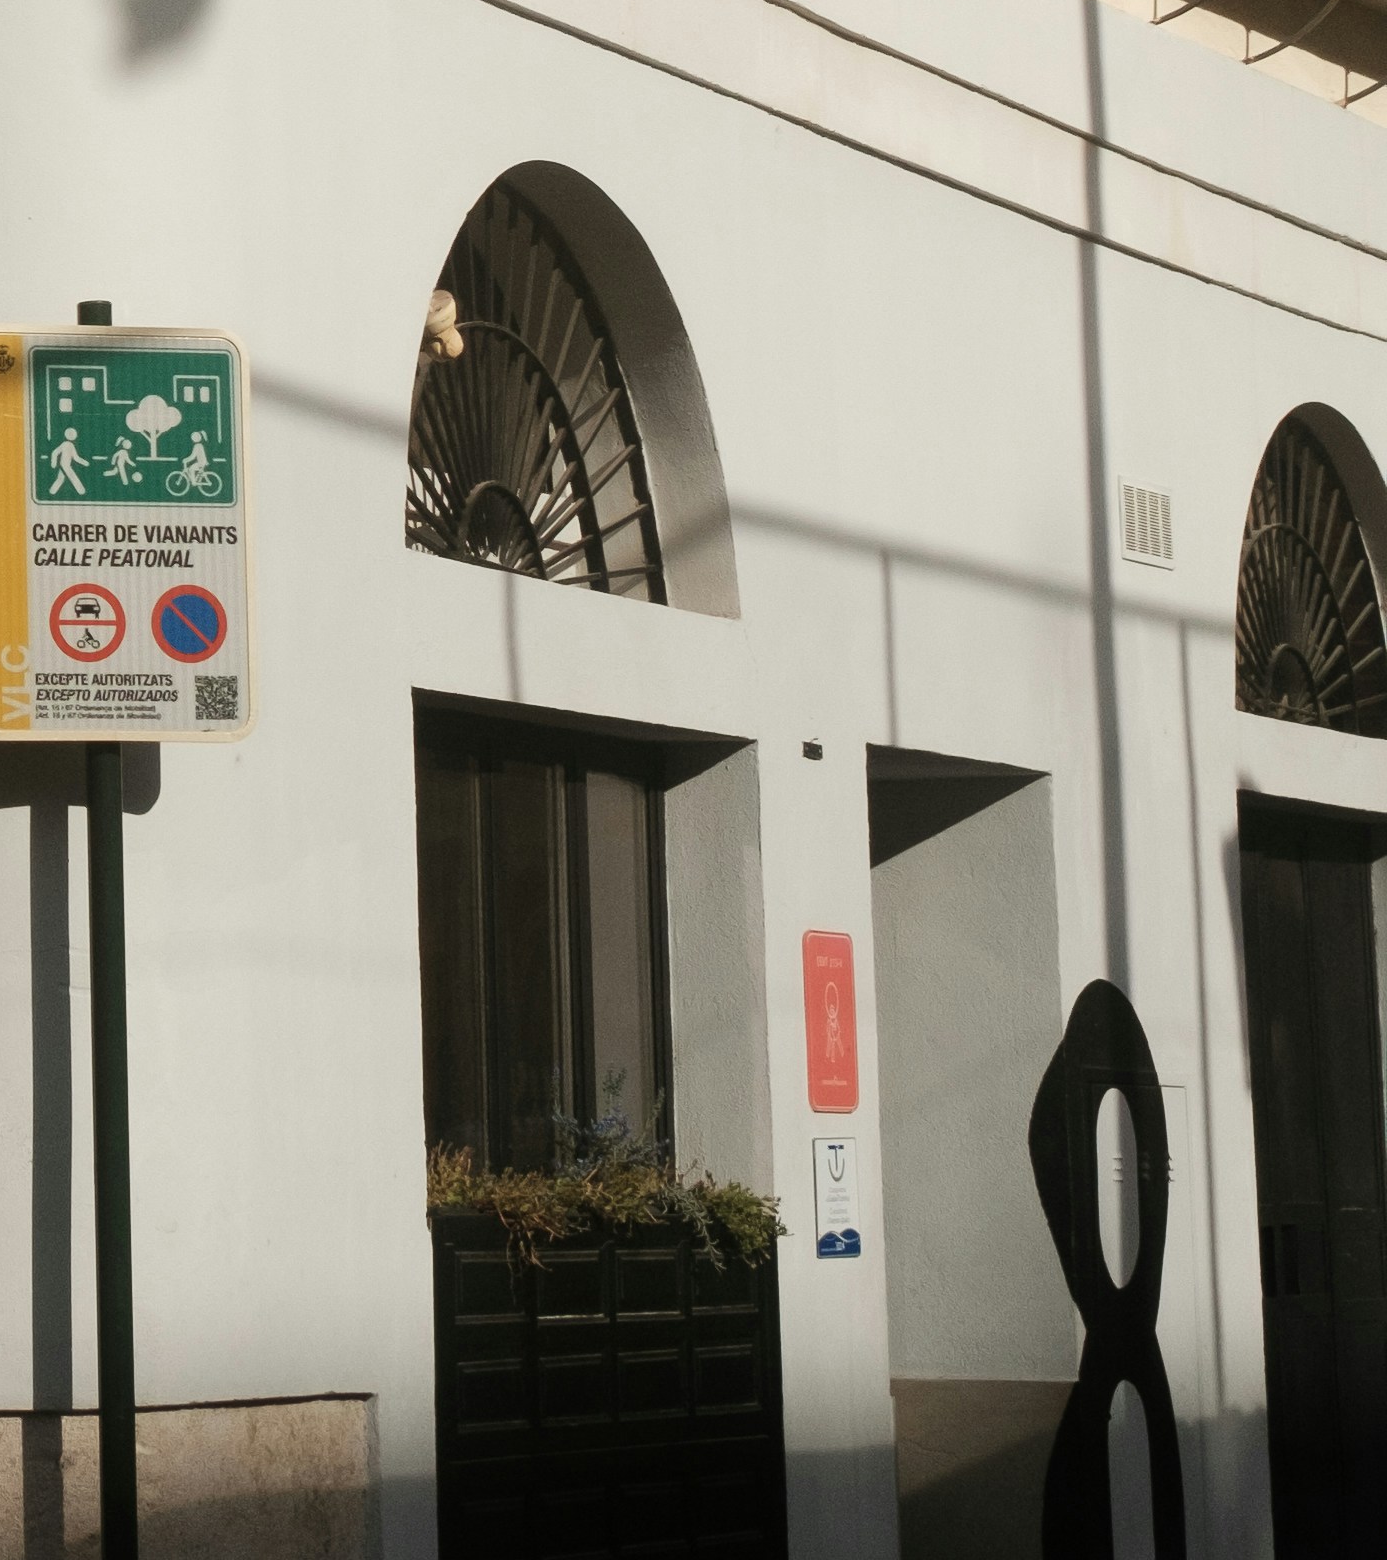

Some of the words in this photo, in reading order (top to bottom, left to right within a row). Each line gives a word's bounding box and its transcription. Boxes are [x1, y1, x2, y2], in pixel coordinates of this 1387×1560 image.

[32, 523, 110, 543] CARRER
[114, 525, 139, 543] DE
[143, 525, 238, 545] VIANANTS
[33, 548, 93, 568] CALLE
[98, 549, 195, 569] PEATONAL
[0, 644, 32, 723] VLC
[35, 673, 89, 686] EXCEPTE
[91, 674, 173, 687] AUTORITZATS
[36, 689, 91, 701] EXCEPTO
[93, 689, 179, 702] AUTORIZADOS
